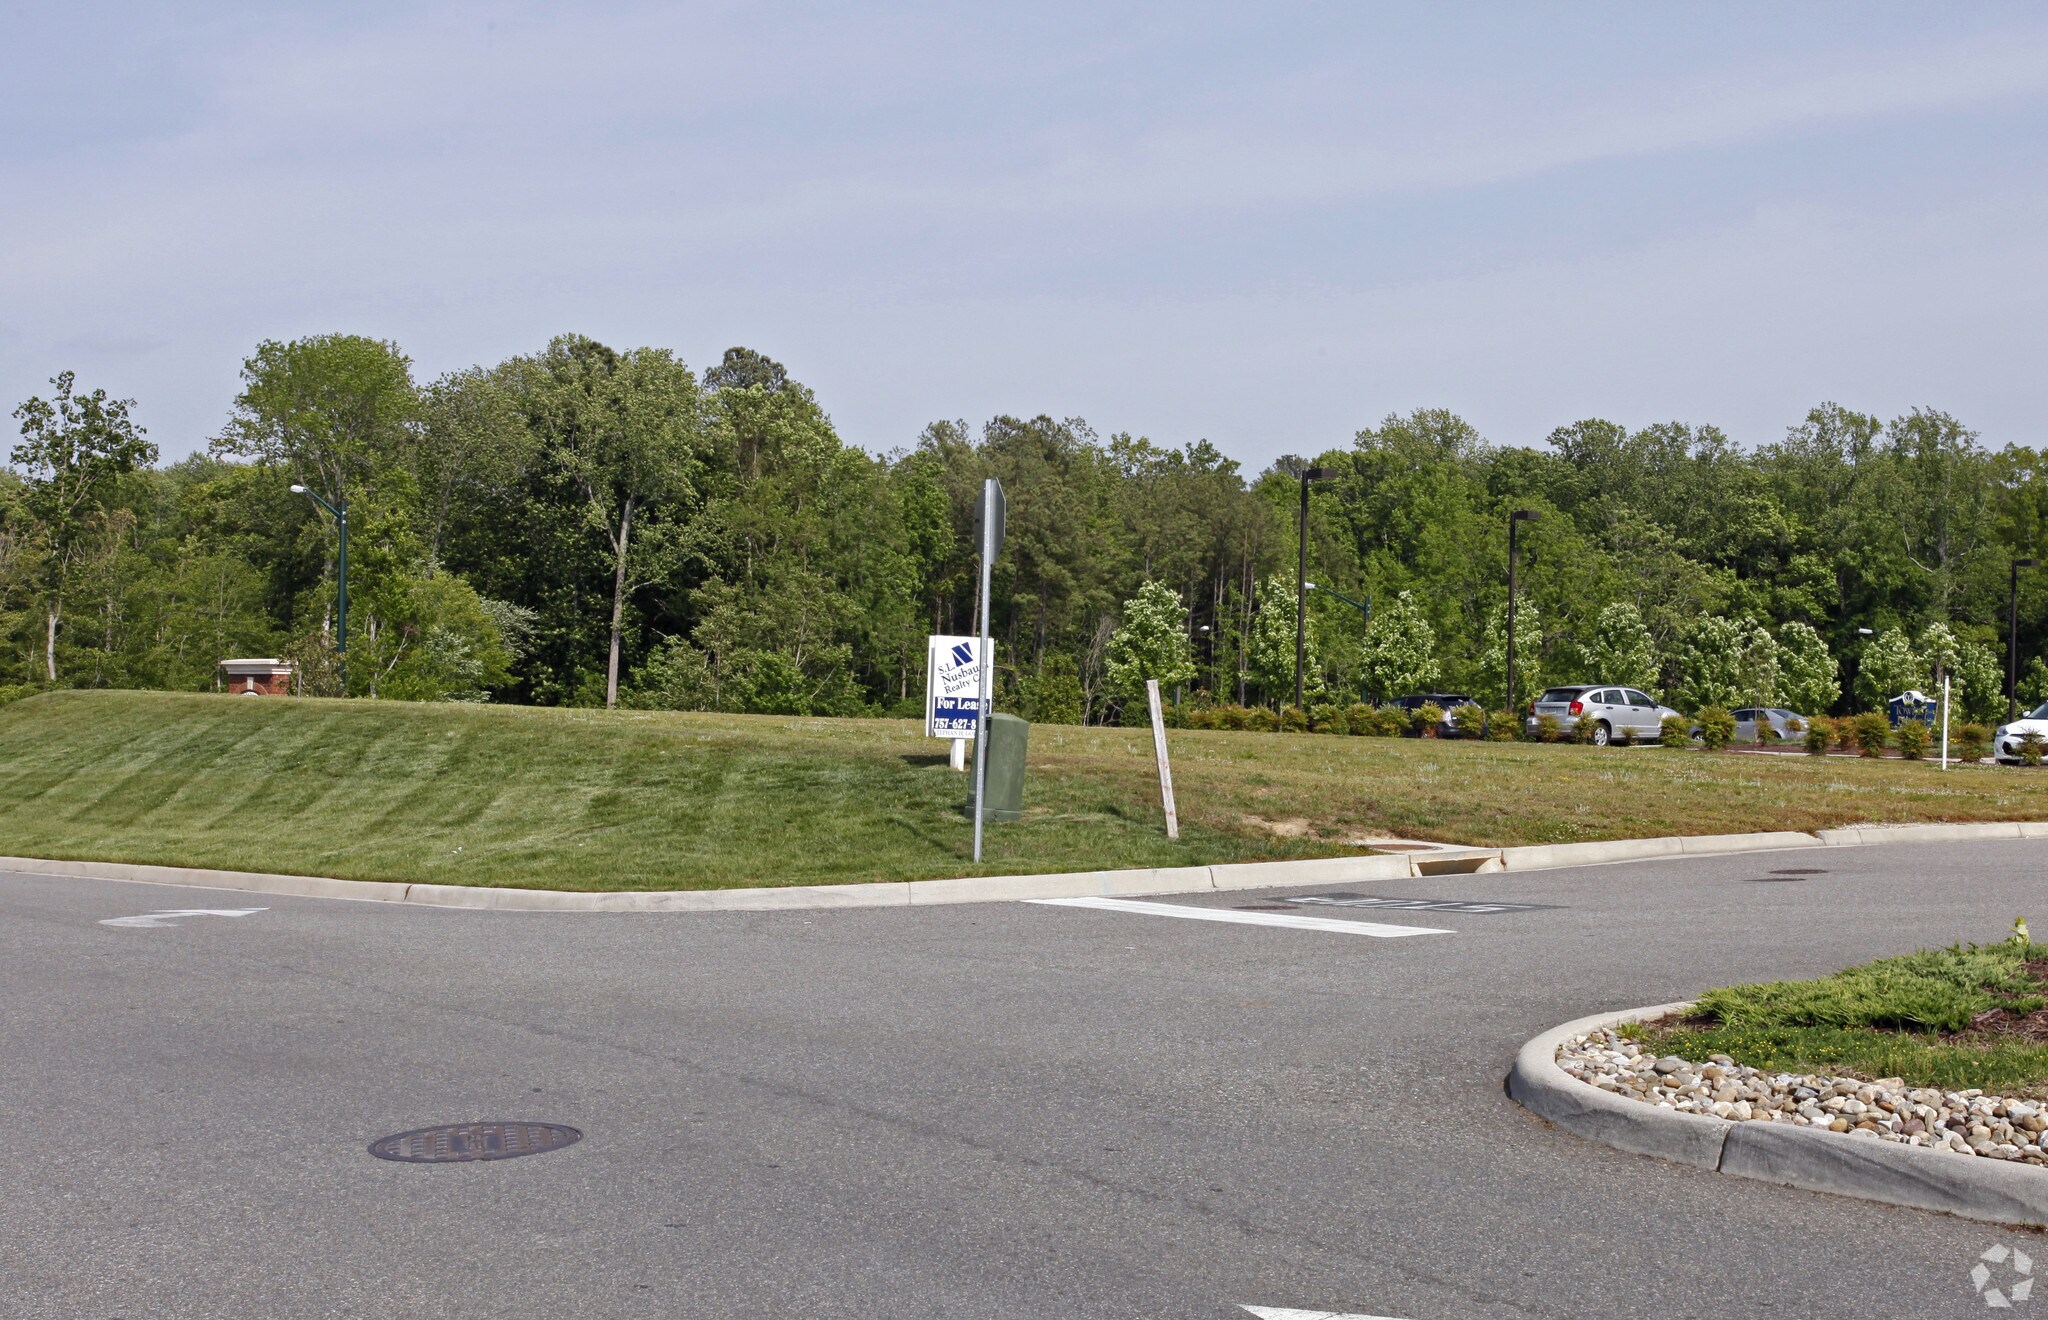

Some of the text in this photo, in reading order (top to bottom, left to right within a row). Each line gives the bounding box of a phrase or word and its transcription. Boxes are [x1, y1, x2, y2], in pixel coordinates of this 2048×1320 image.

[941, 664, 989, 685] Nusbau
[944, 679, 970, 694] Realty
[937, 696, 956, 710] For
[935, 718, 977, 730] 757-627-8
